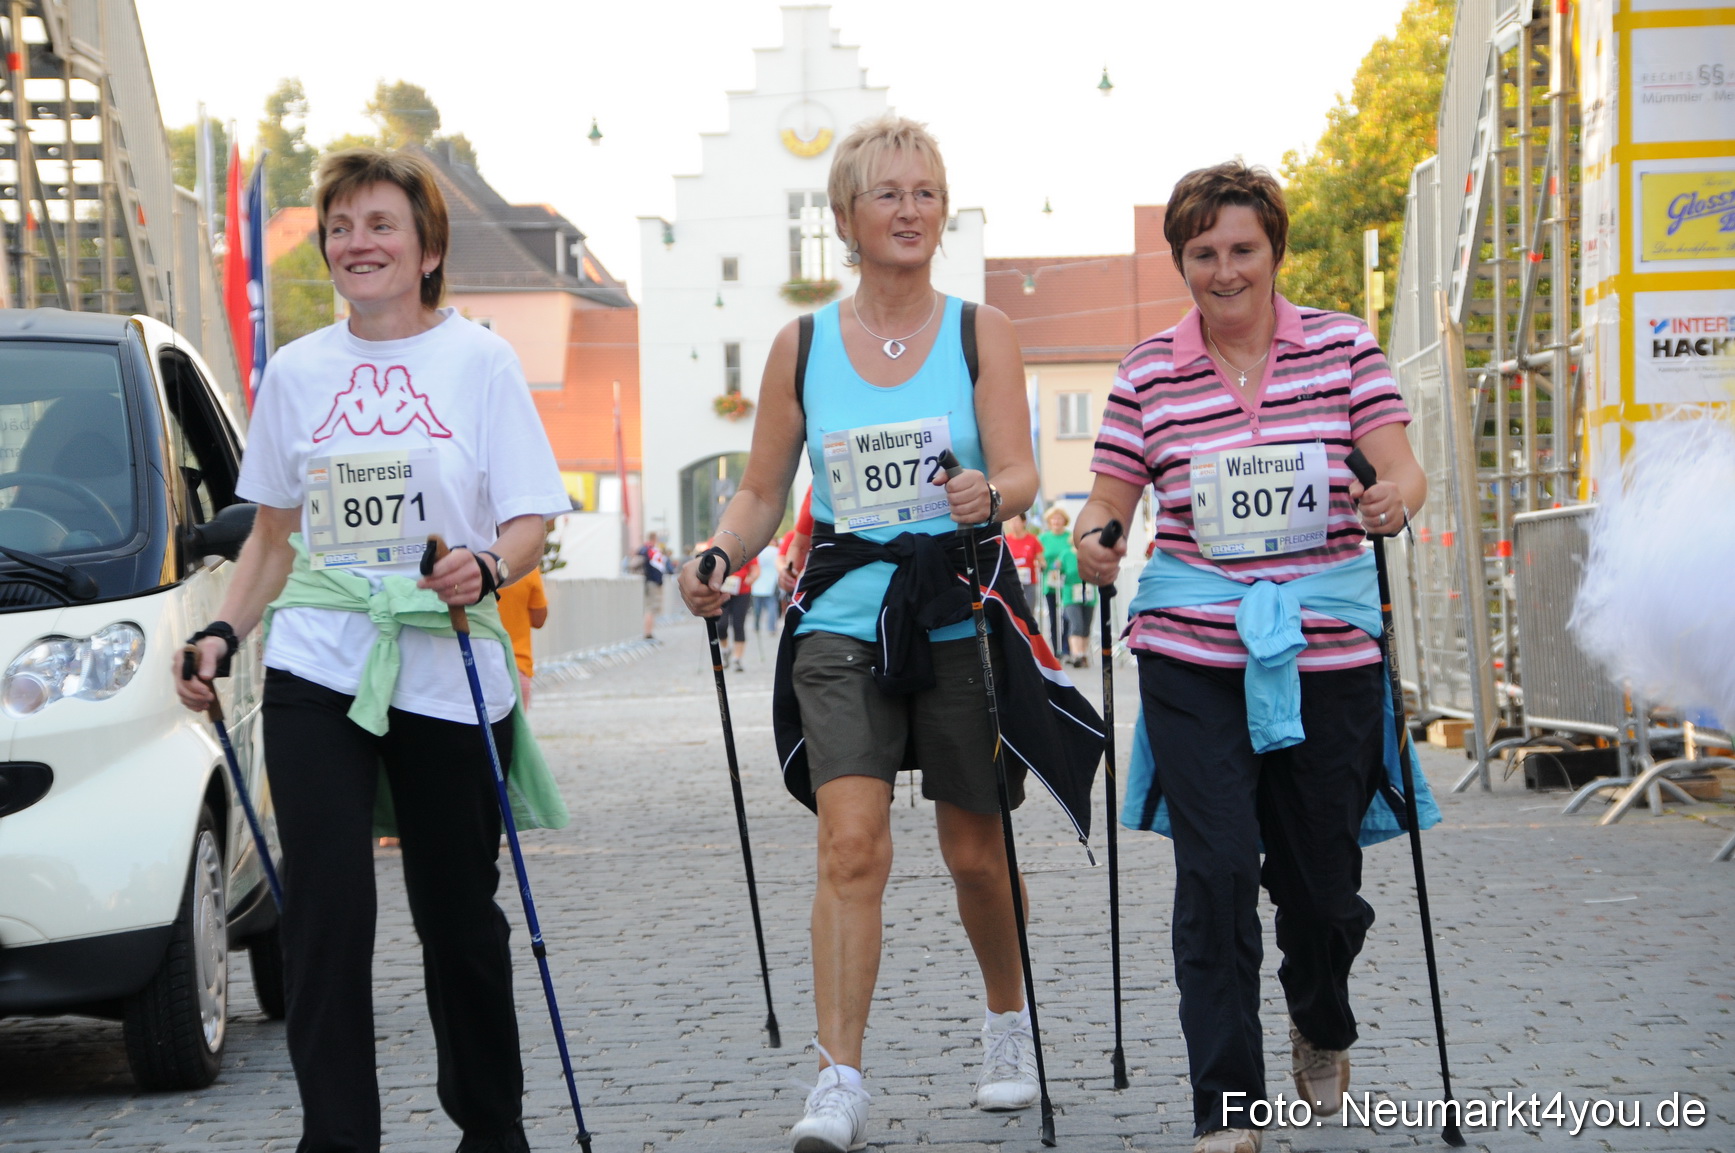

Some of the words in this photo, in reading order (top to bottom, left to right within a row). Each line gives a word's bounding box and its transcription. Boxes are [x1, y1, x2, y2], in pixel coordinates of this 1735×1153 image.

[1642, 71, 1694, 82] RECHTS
[856, 430, 932, 453] Walburga
[336, 460, 413, 484] Theresia
[832, 469, 841, 483] N
[864, 456, 940, 492] 8072
[1226, 452, 1305, 477] Waltraud
[311, 499, 319, 514] N
[344, 491, 426, 528] 8071
[1197, 492, 1206, 507] N
[1232, 484, 1317, 519] 8074
[392, 543, 427, 556] PFLEIDE
[1280, 530, 1325, 545] PFLEIDERER
